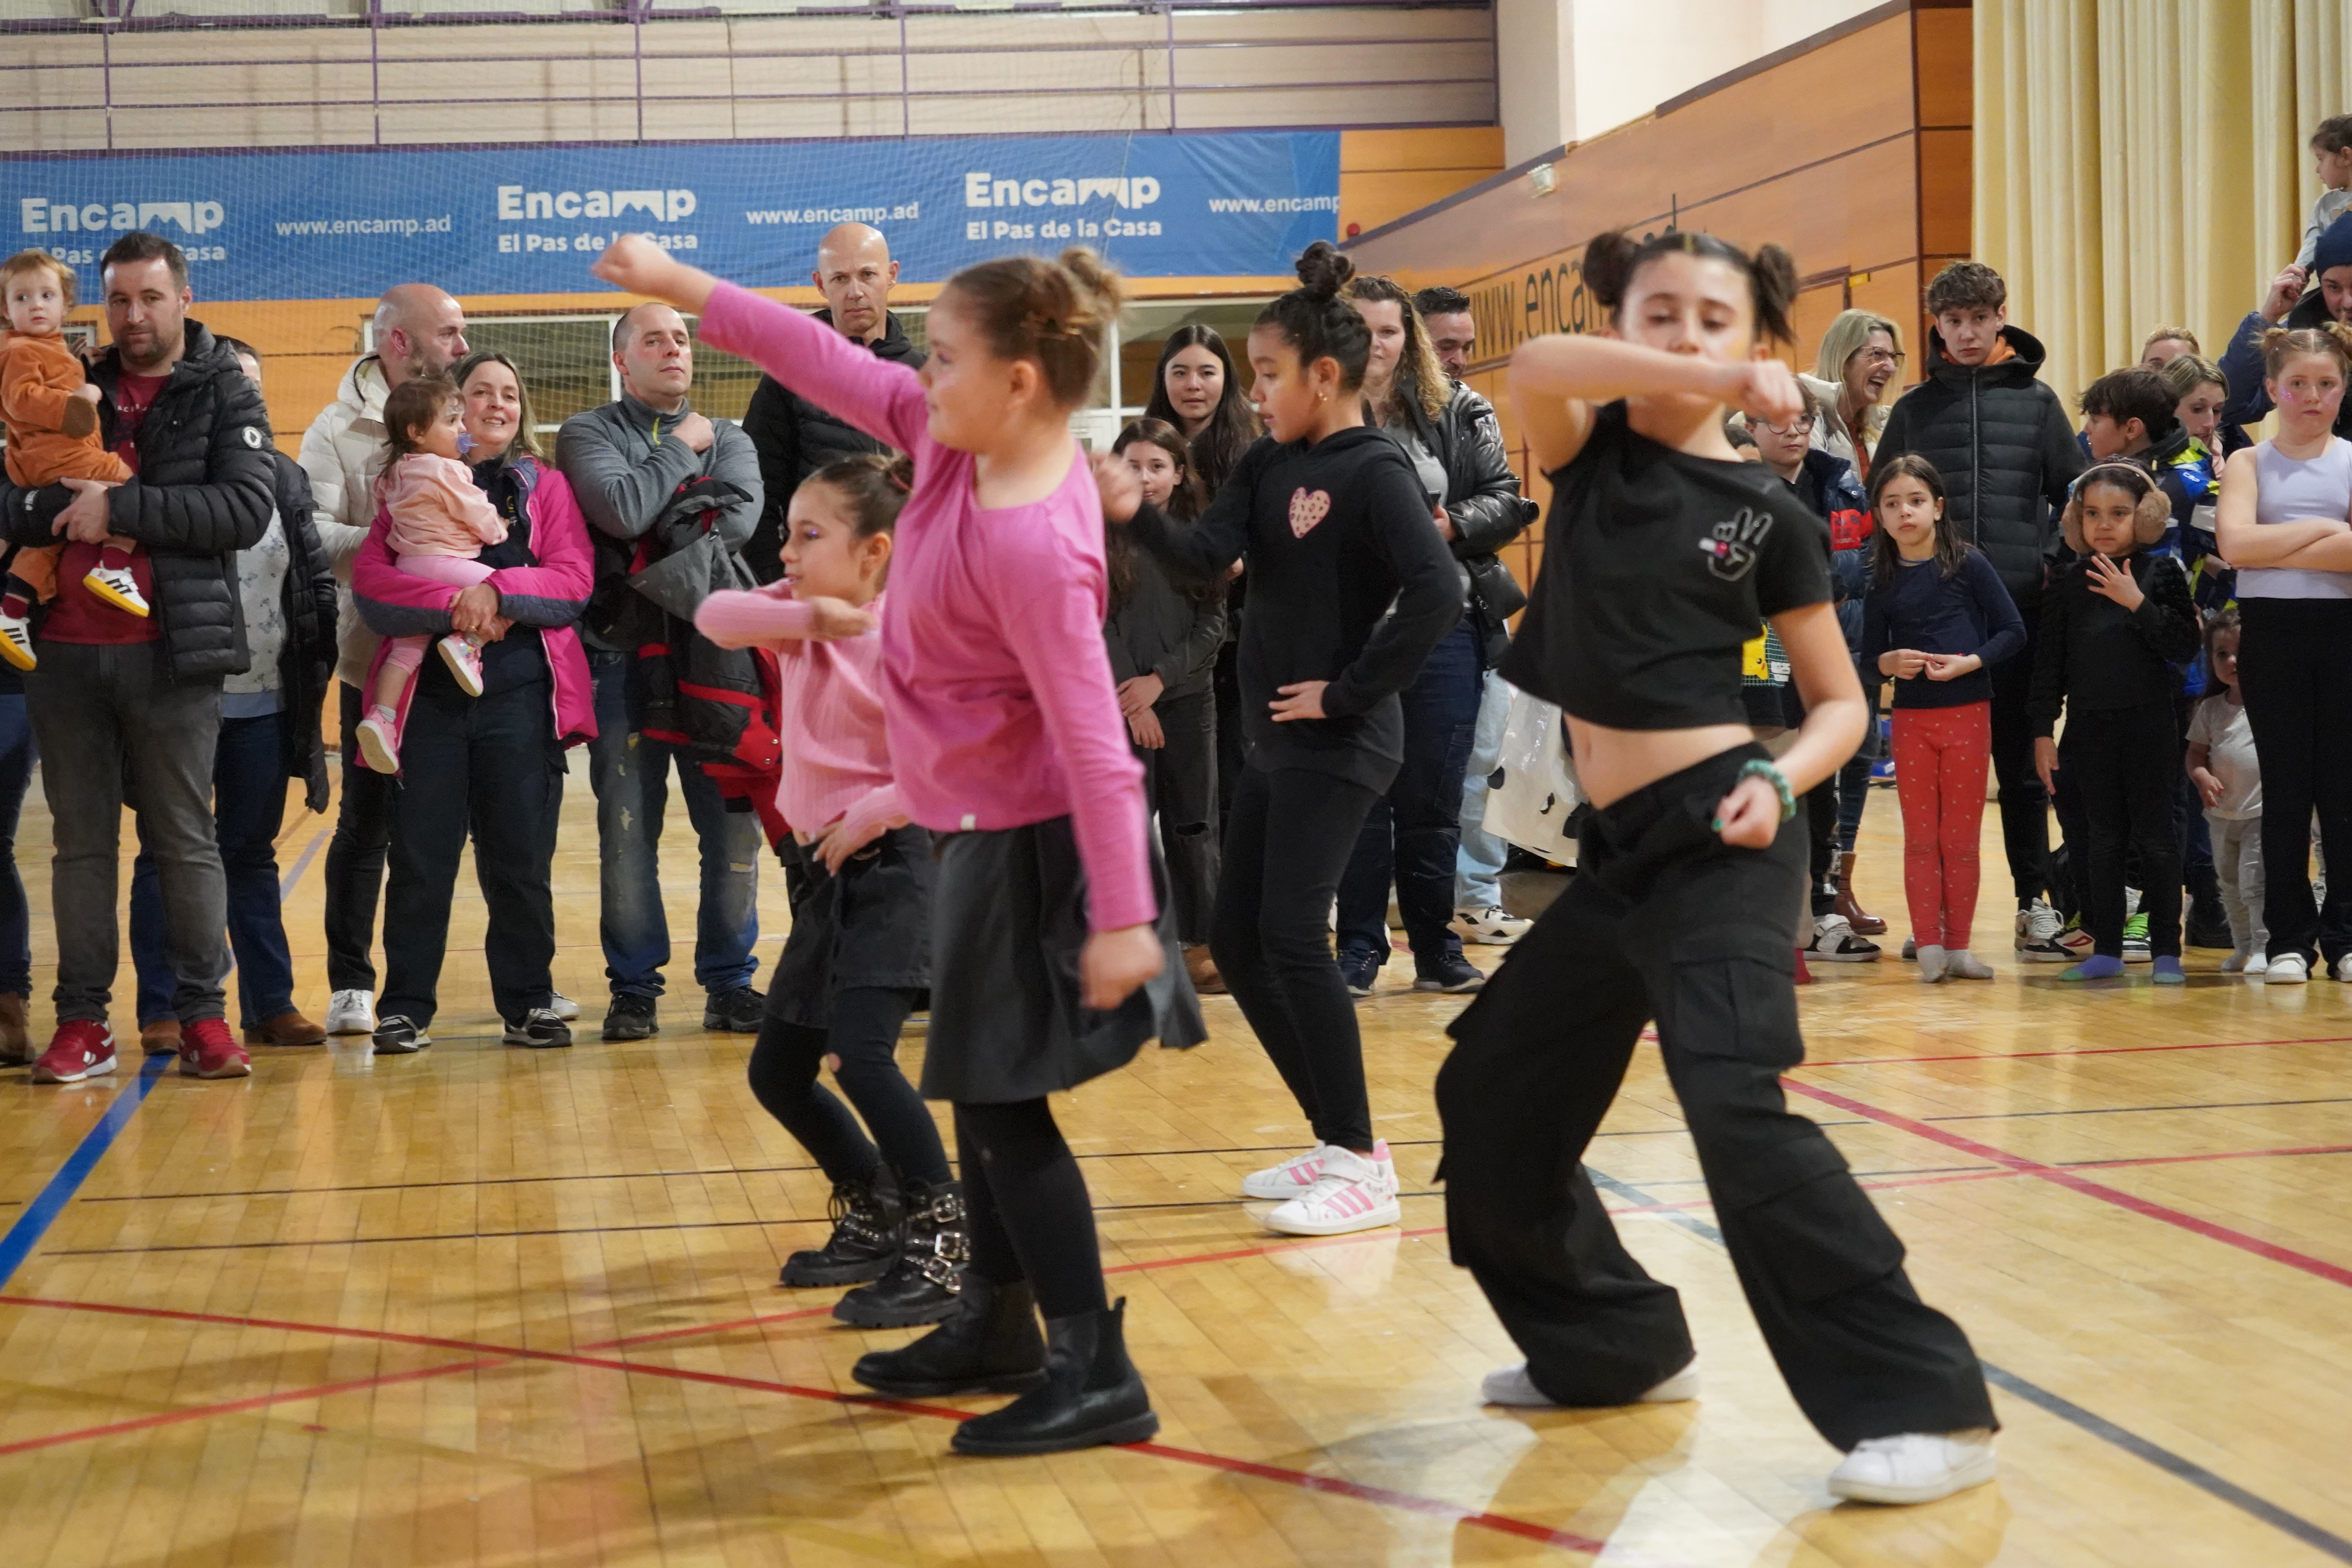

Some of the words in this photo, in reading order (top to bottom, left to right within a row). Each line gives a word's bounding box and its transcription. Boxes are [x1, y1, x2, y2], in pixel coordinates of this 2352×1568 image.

[965, 172, 1161, 209] Encamp
[497, 185, 696, 222] Encamp
[746, 201, 919, 225] www.encamp.ad
[22, 198, 224, 234] Encamp
[275, 214, 450, 237] www.encamp.ad
[967, 220, 987, 240] El
[994, 221, 1034, 240] Pas
[1040, 220, 1071, 238] de
[1077, 218, 1098, 237] la
[1103, 218, 1162, 237] Casa
[499, 233, 520, 252] El
[526, 234, 568, 252] Pas
[574, 233, 605, 251] de
